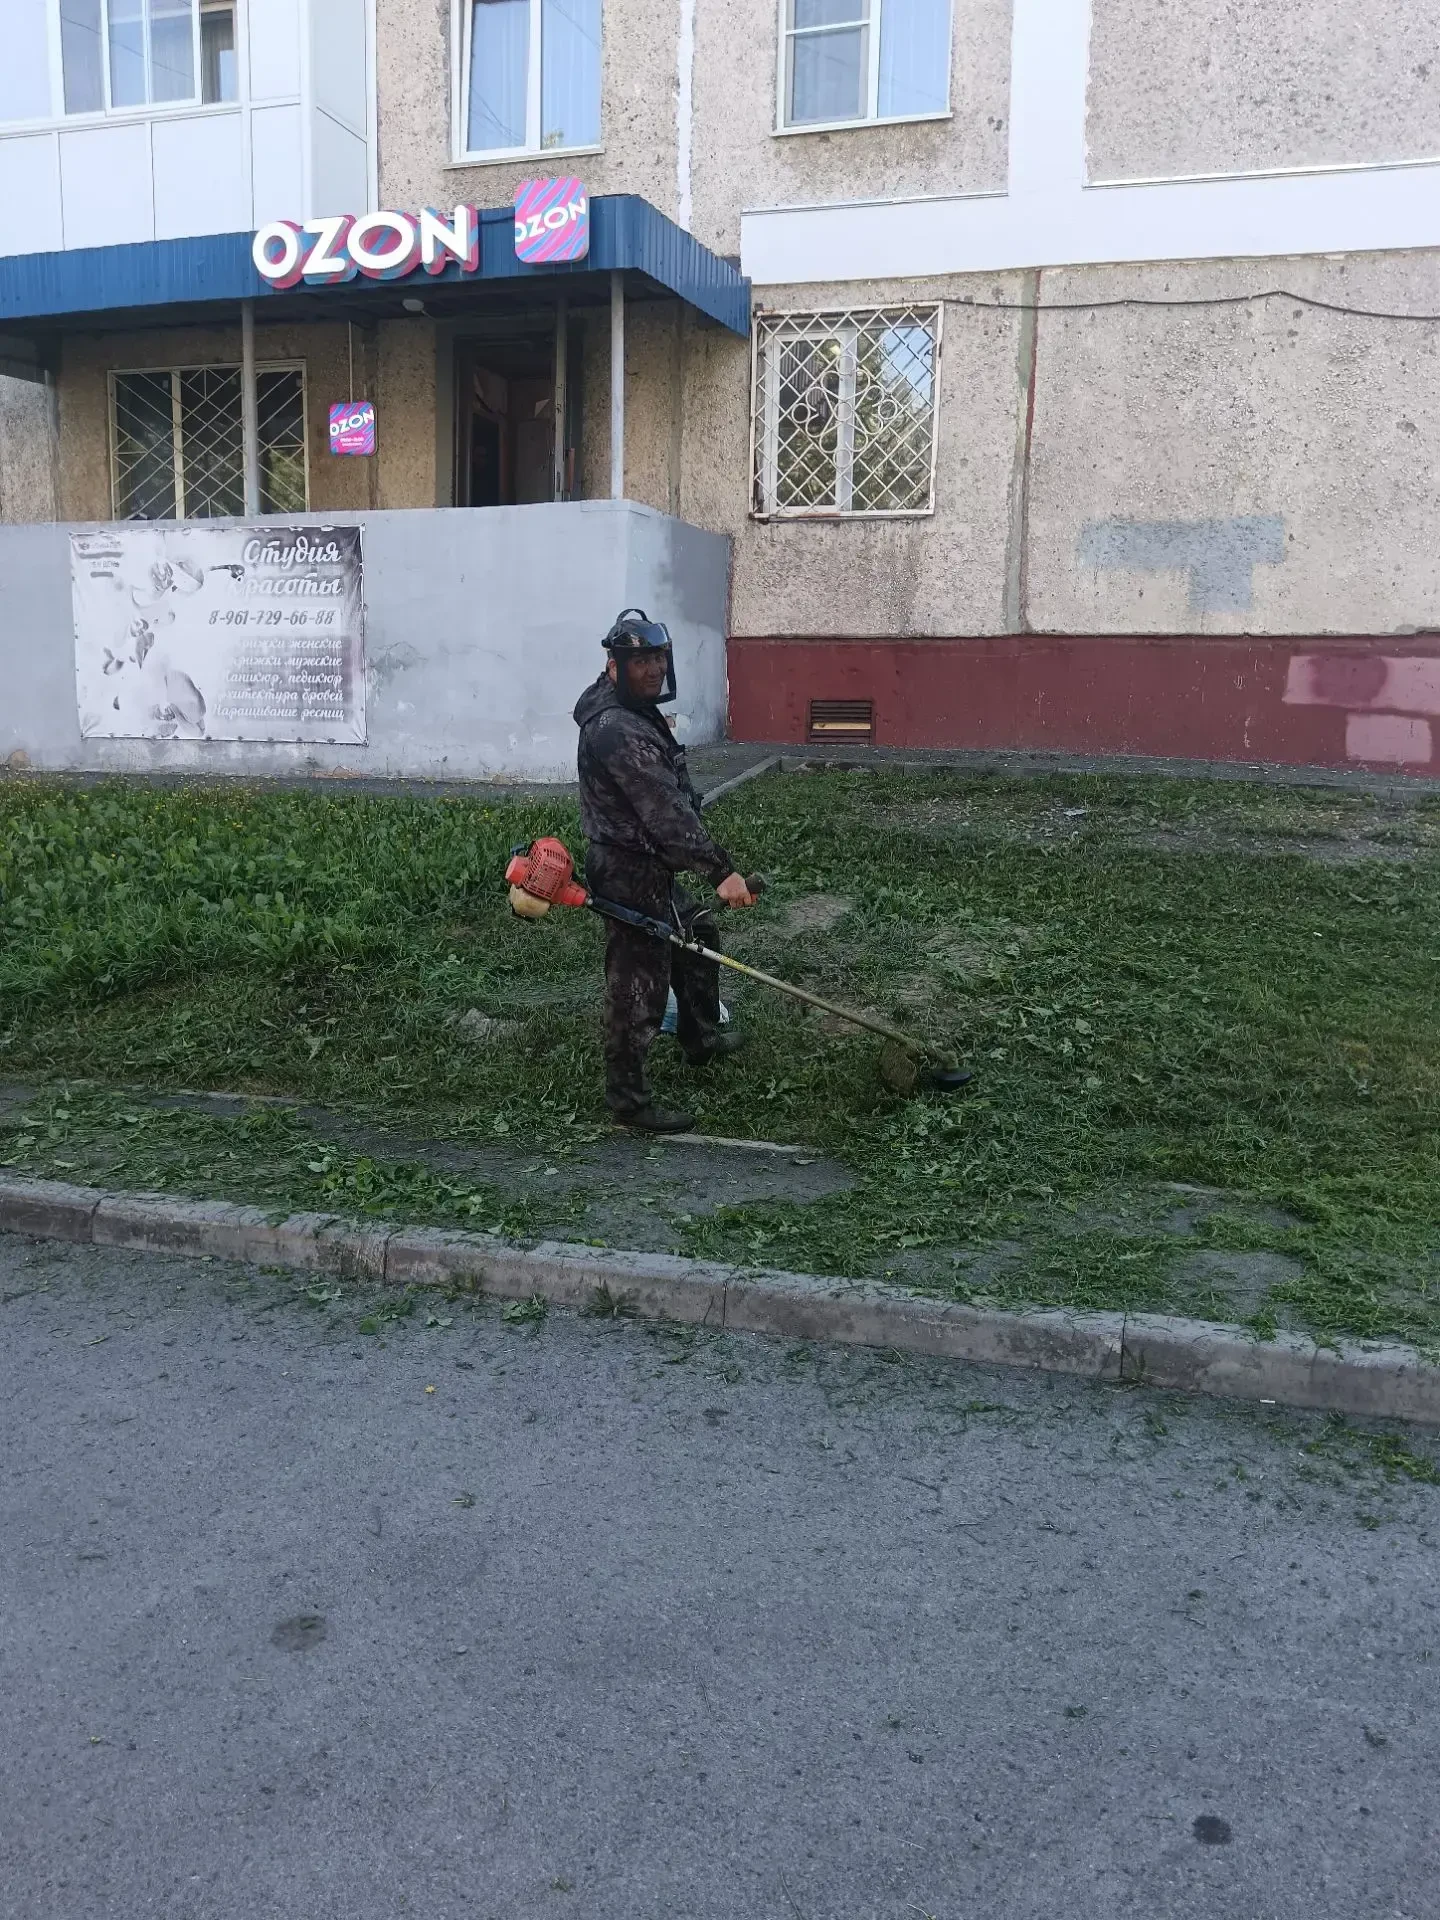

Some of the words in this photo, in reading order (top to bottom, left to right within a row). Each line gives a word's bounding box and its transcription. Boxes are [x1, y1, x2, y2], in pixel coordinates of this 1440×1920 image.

[515, 197, 587, 243] OZON
[252, 203, 474, 284] OZON
[329, 409, 374, 436] OZON
[243, 536, 342, 569] Студия
[208, 608, 336, 626] 8-961-729-66-88
[288, 637, 343, 650] женские
[287, 670, 344, 688] педикюр
[301, 687, 344, 704] бровей
[300, 706, 345, 722] ресниц
